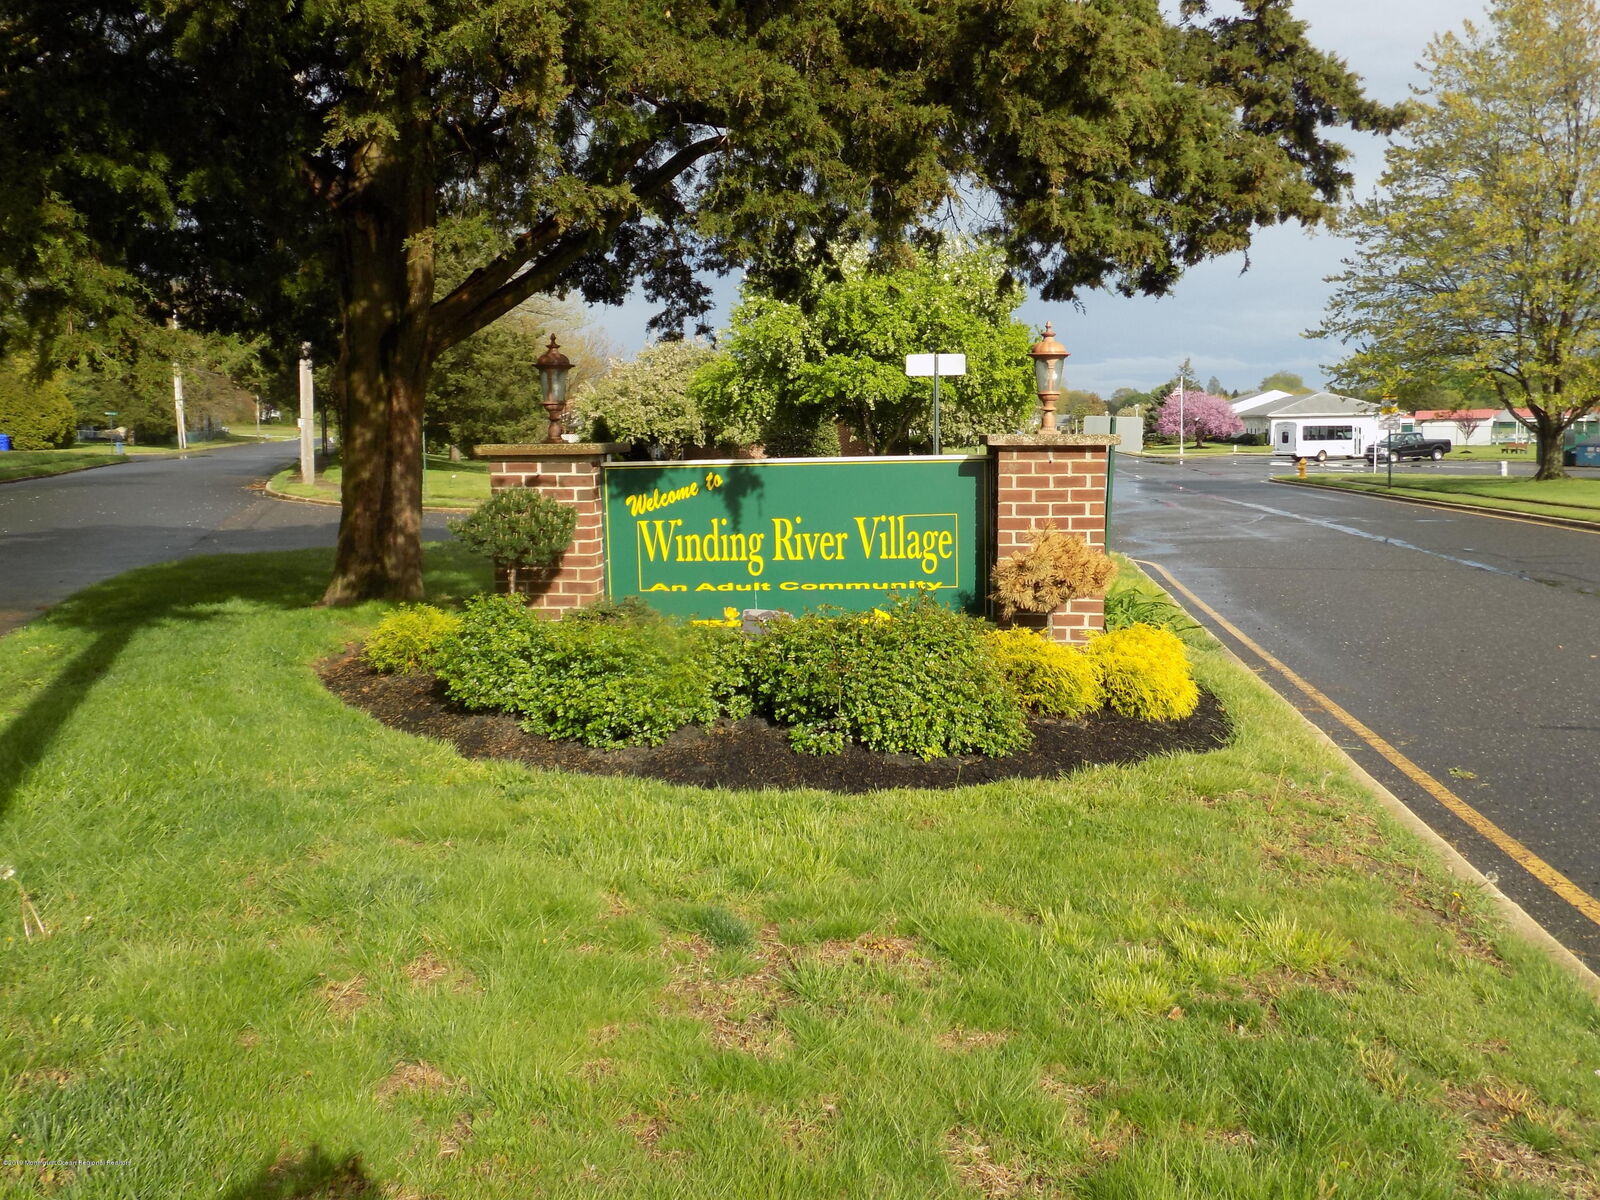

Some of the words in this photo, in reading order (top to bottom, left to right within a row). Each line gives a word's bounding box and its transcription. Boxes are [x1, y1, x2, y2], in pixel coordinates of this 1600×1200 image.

[625, 482, 699, 517] Welcome
[705, 471, 723, 491] to
[637, 517, 765, 577] Winding
[772, 516, 848, 562] River
[853, 514, 953, 575] Village
[649, 582, 687, 592] An
[695, 581, 771, 592] Adult
[779, 580, 943, 591] Community
